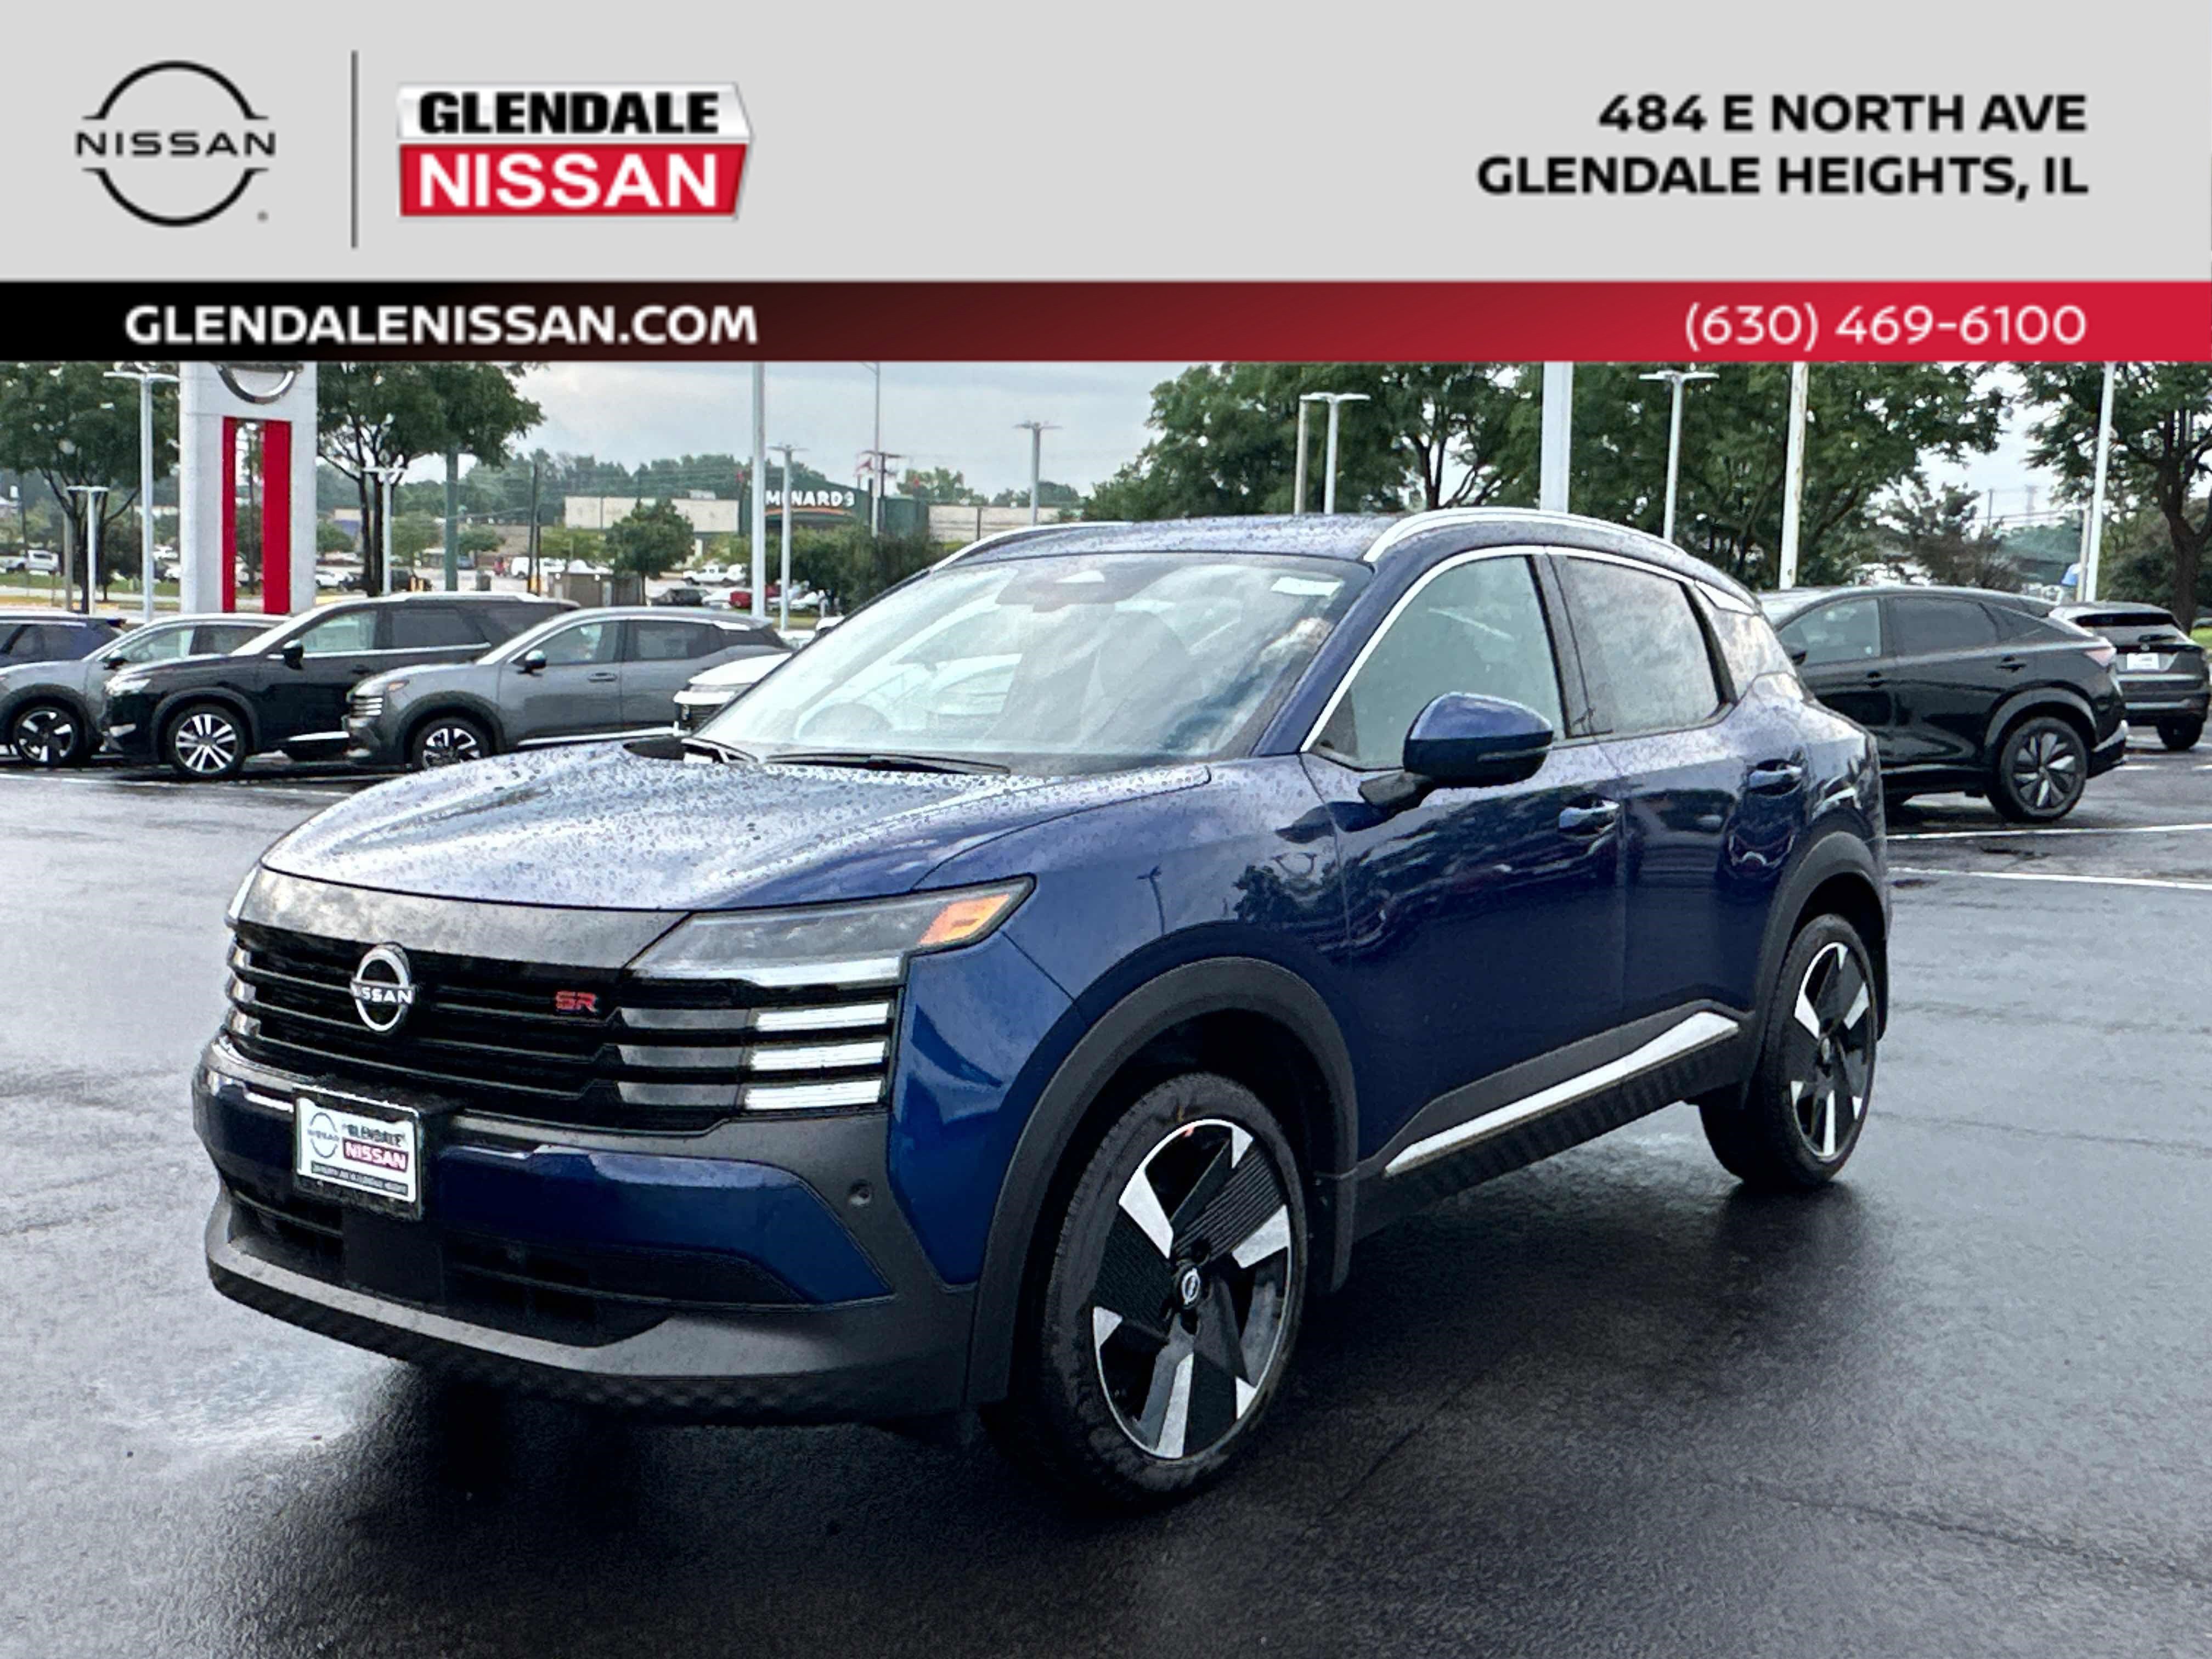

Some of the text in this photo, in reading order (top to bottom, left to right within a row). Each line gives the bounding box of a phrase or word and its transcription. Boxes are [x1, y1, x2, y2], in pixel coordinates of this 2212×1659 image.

[765, 489, 855, 507] MNARDS
[555, 990, 599, 1013] SR
[345, 1141, 407, 1170] NISSAN
